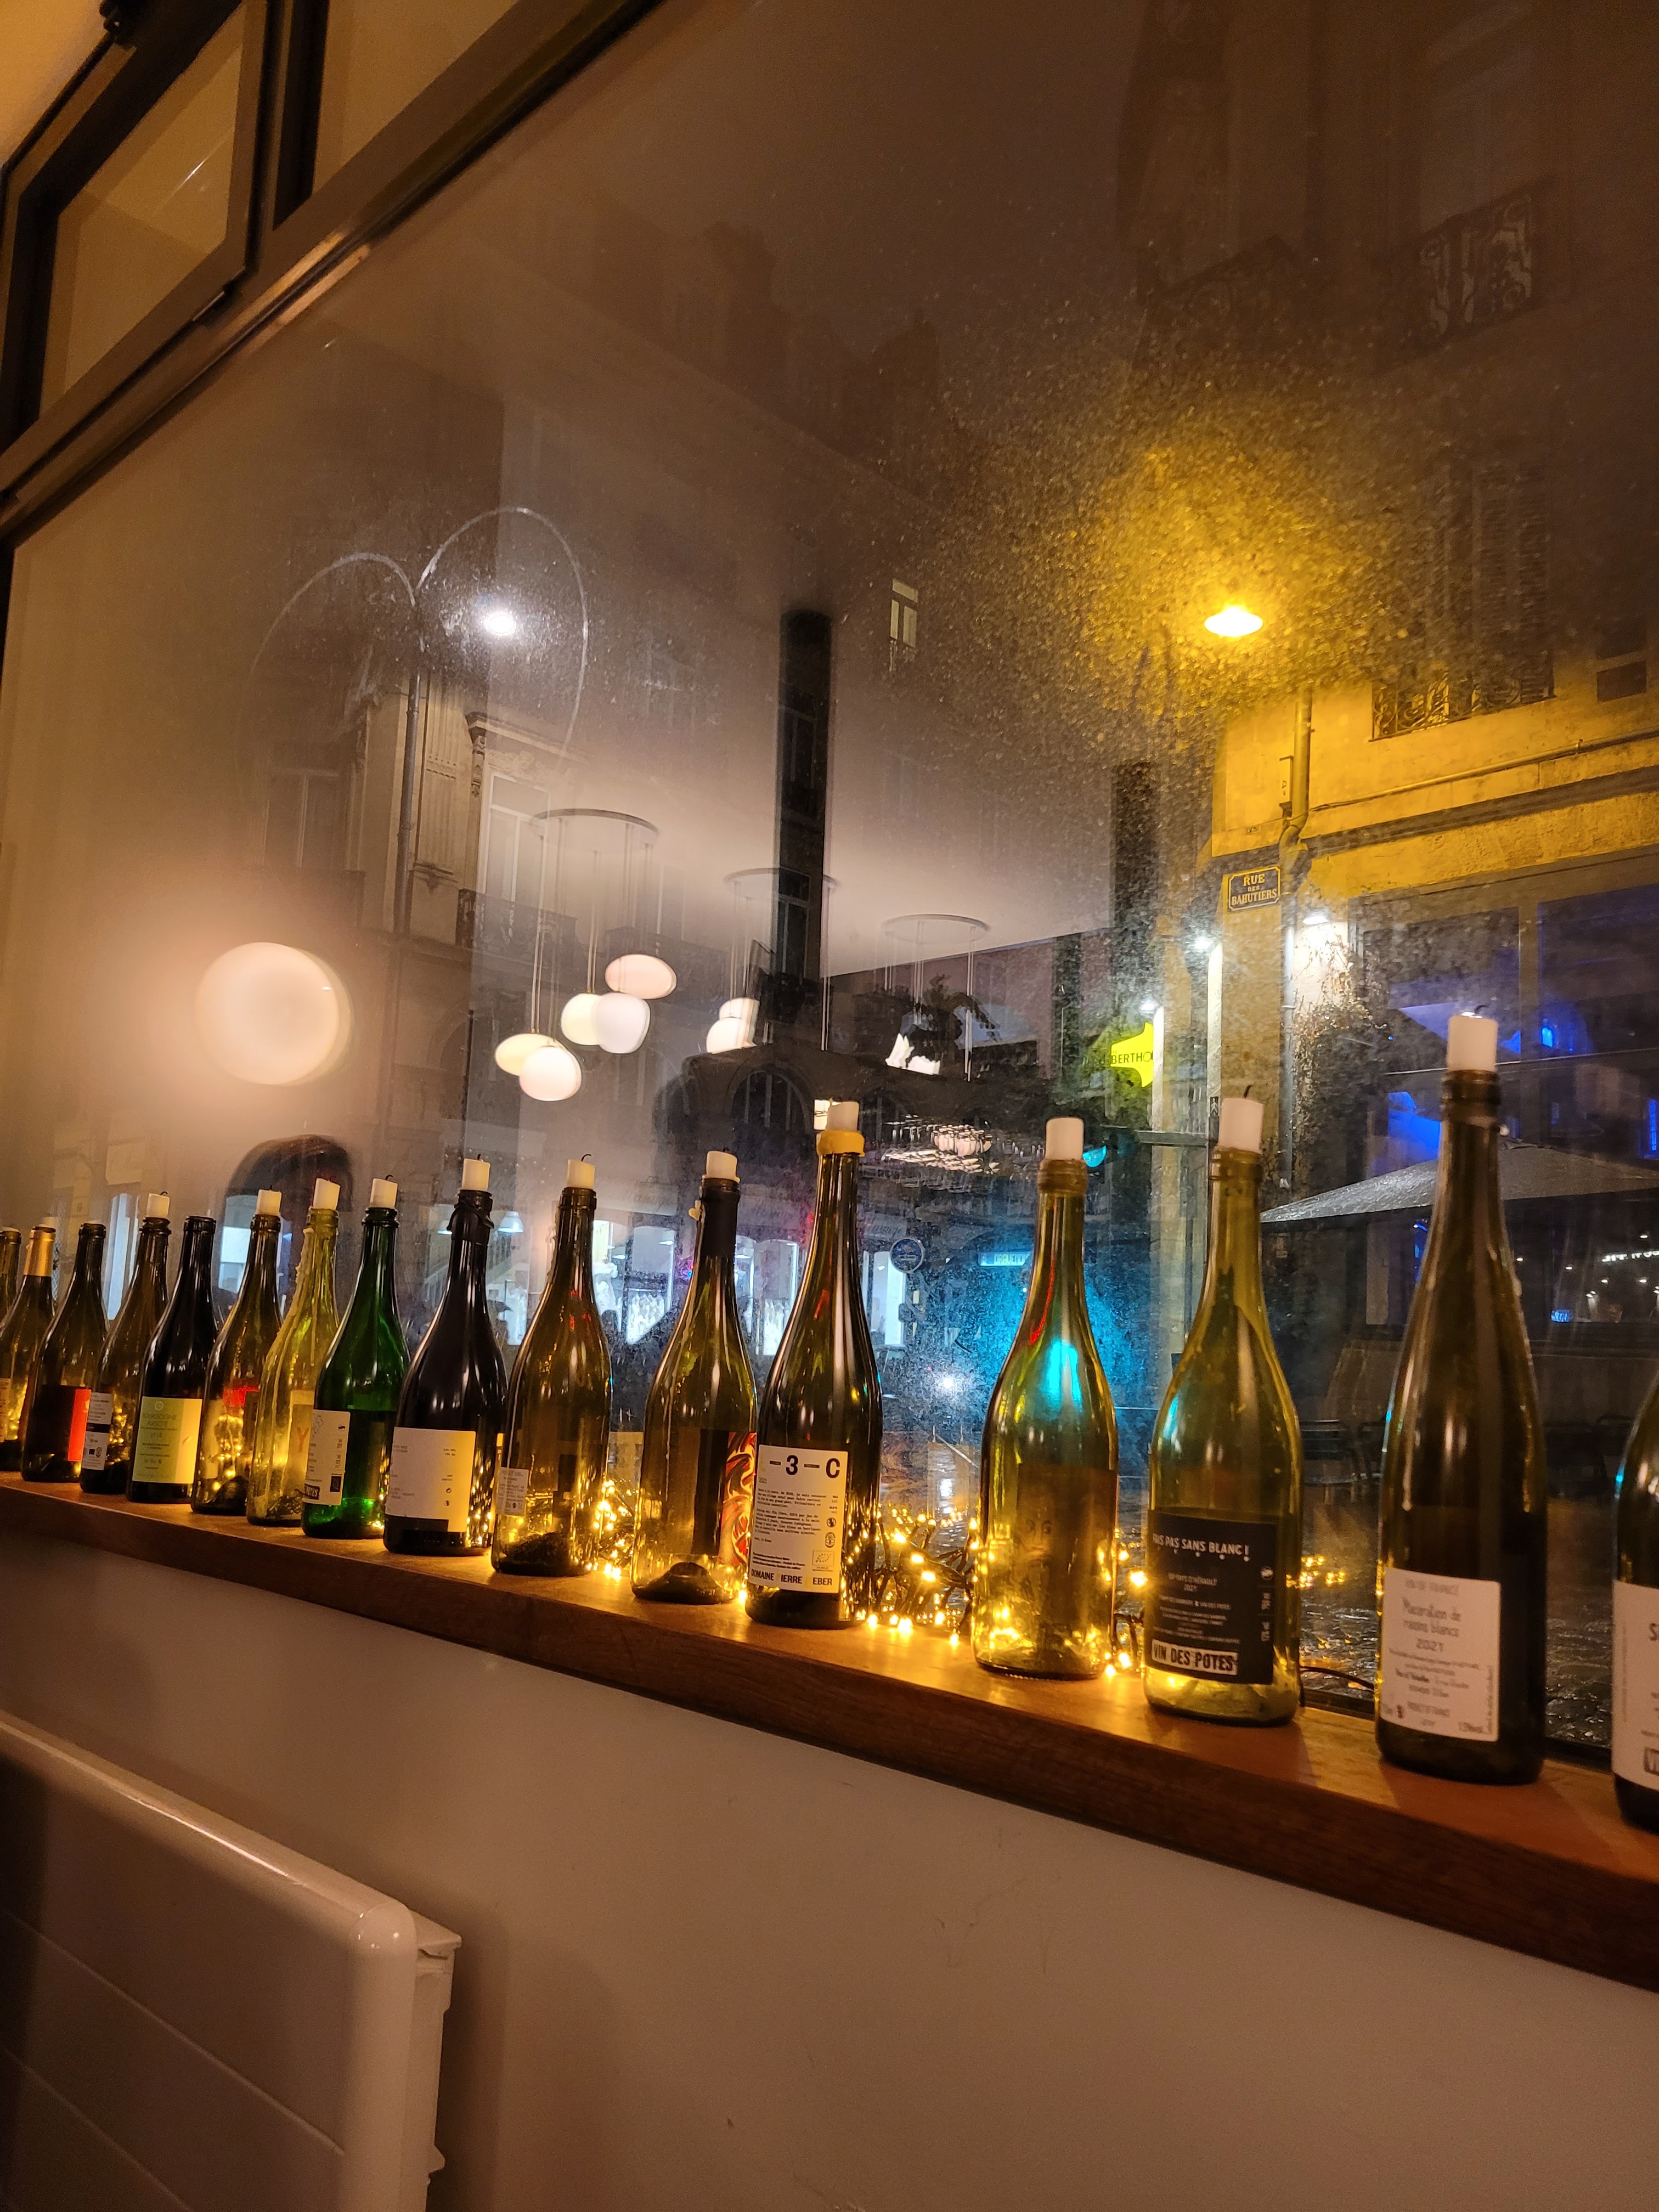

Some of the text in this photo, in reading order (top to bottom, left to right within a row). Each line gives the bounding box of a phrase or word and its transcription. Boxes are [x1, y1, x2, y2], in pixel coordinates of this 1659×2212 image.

[1243, 874, 1265, 887] RUE
[1232, 888, 1277, 906] BAHUTIERS
[1165, 1536, 1180, 1548] PAS
[1181, 1538, 1206, 1552] SANS
[1209, 1541, 1243, 1555] BLANC
[751, 1568, 775, 1581] DOMAINE
[777, 1573, 803, 1584] IERRE
[1154, 1643, 1233, 1672] VIN DES POTES
